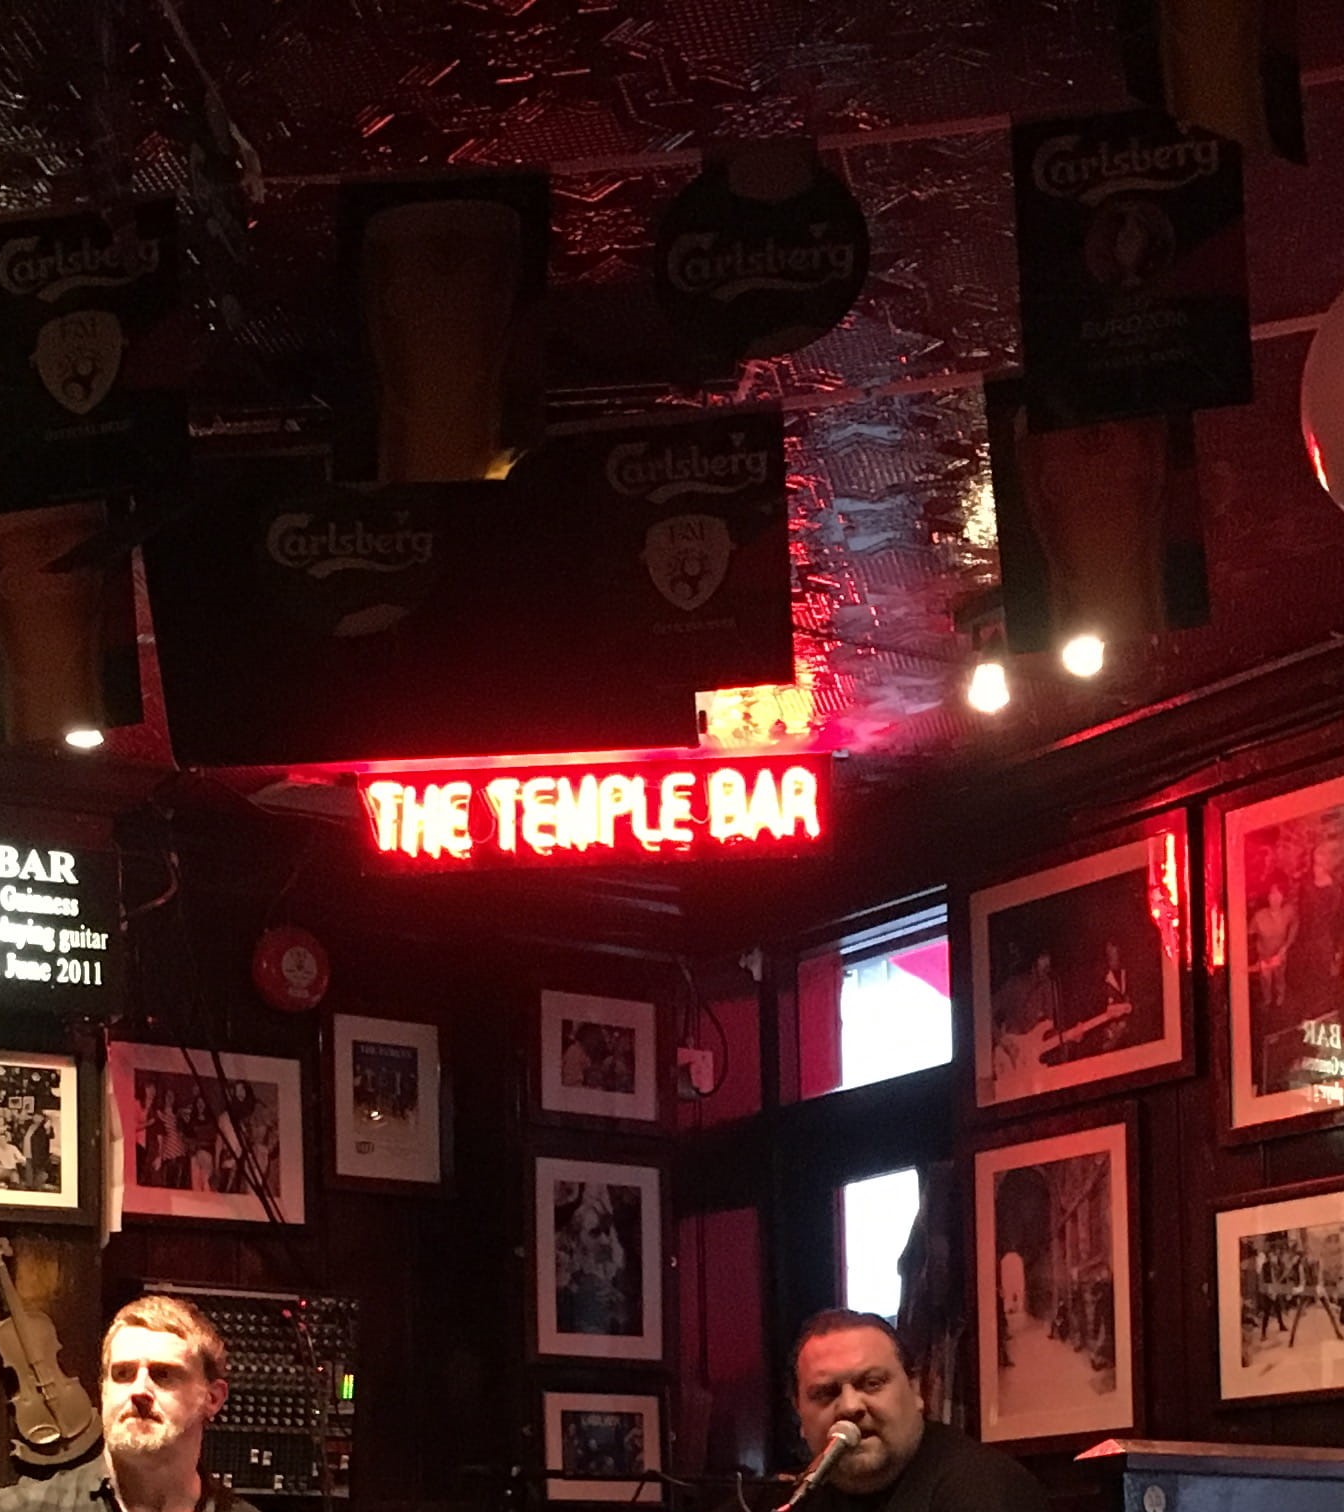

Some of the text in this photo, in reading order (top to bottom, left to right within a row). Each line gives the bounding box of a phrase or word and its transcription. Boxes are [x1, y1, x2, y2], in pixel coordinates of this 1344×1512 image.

[1031, 134, 1220, 207] Carlsberg
[666, 230, 855, 300] Carlsberg
[605, 438, 768, 504] Carlsberg
[265, 512, 433, 579] Carlsberg
[367, 766, 820, 859] THE TEMPLE BAR
[0, 885, 79, 917] Guinness
[5, 952, 52, 982] June
[56, 957, 102, 985] 2011
[59, 924, 109, 953] guitar
